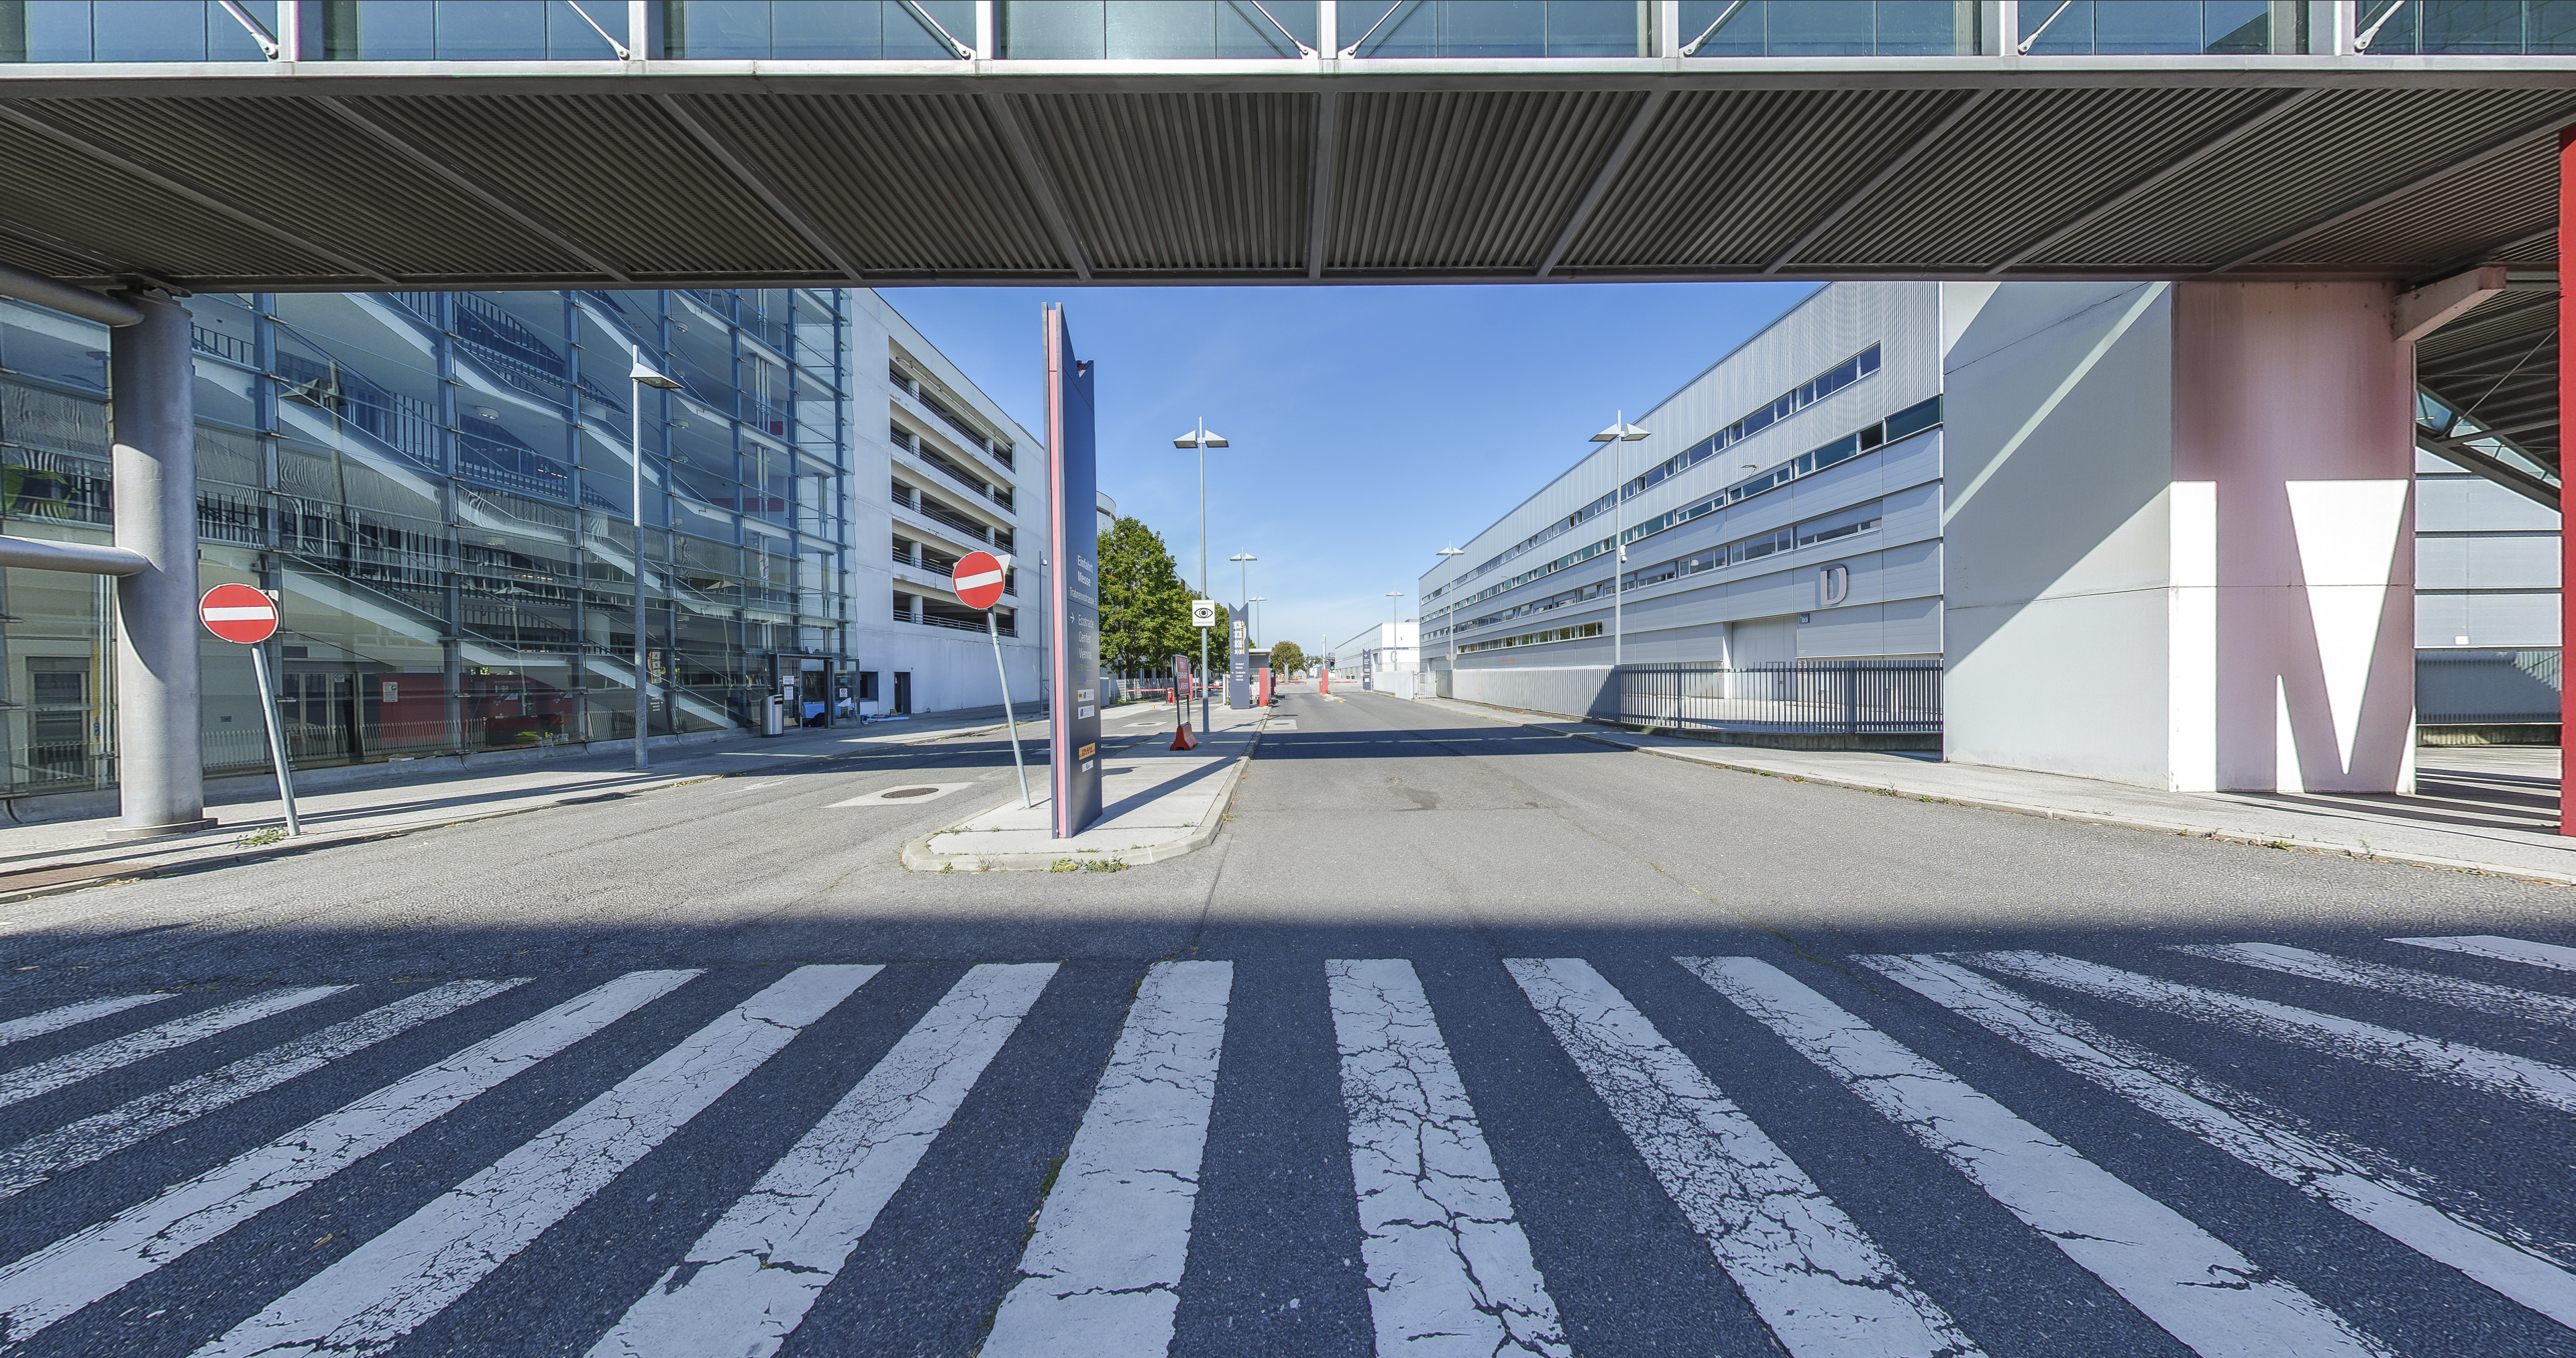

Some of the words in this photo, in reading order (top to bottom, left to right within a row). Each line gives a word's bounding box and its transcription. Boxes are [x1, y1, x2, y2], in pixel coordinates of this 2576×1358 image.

[1077, 555, 1093, 573] Einfahrt
[1077, 570, 1091, 587] Messe
[1820, 563, 1847, 606] D
[1069, 586, 1095, 605] Trabrennstrasse
[1094, 598, 1097, 606] 5
[1078, 614, 1095, 629] Ecotrade
[1078, 630, 1091, 644] Center
[1078, 647, 1092, 660] Vienna
[1390, 650, 1397, 663] C
[1081, 746, 1093, 756] DHL
